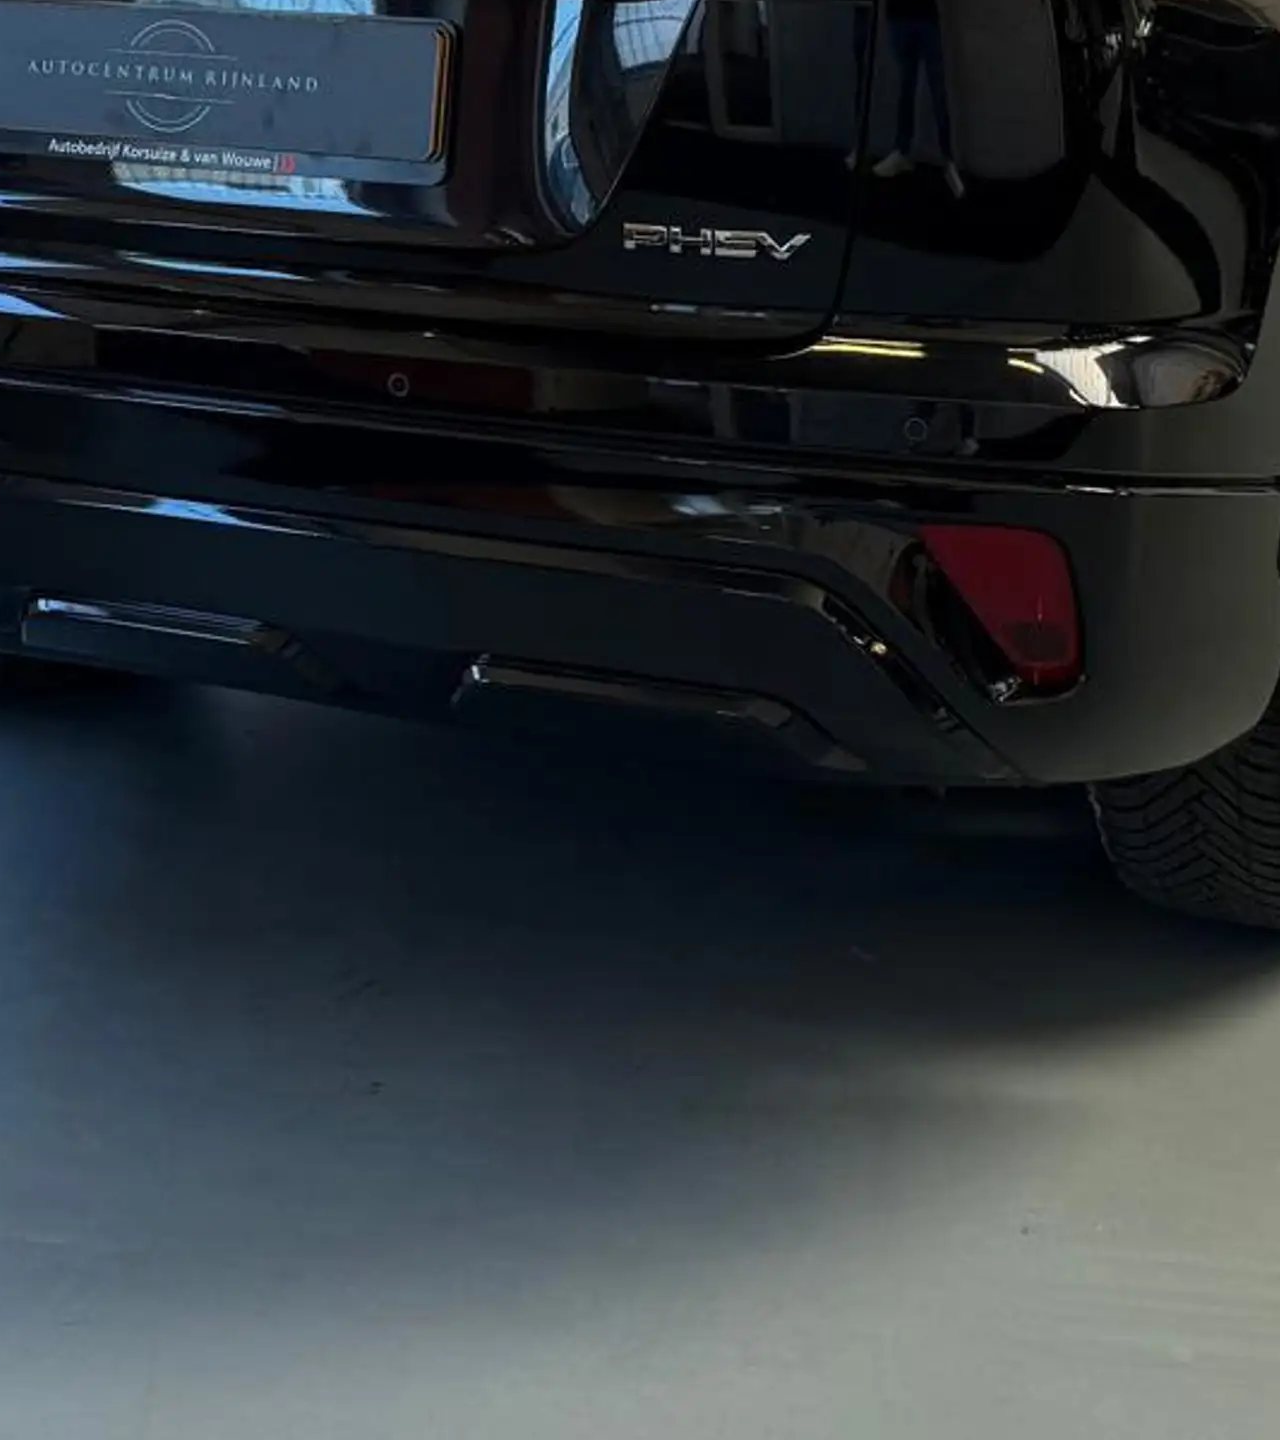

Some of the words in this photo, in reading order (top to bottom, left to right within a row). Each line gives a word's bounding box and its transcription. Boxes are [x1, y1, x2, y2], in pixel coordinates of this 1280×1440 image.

[27, 58, 194, 84] AUTOCENTRUM
[204, 68, 319, 93] RIJNLAND
[48, 137, 121, 161] Autobedrijf
[179, 148, 190, 163] &
[193, 151, 218, 165] van
[221, 151, 272, 169] Wouwe
[623, 222, 812, 260] PHEV
